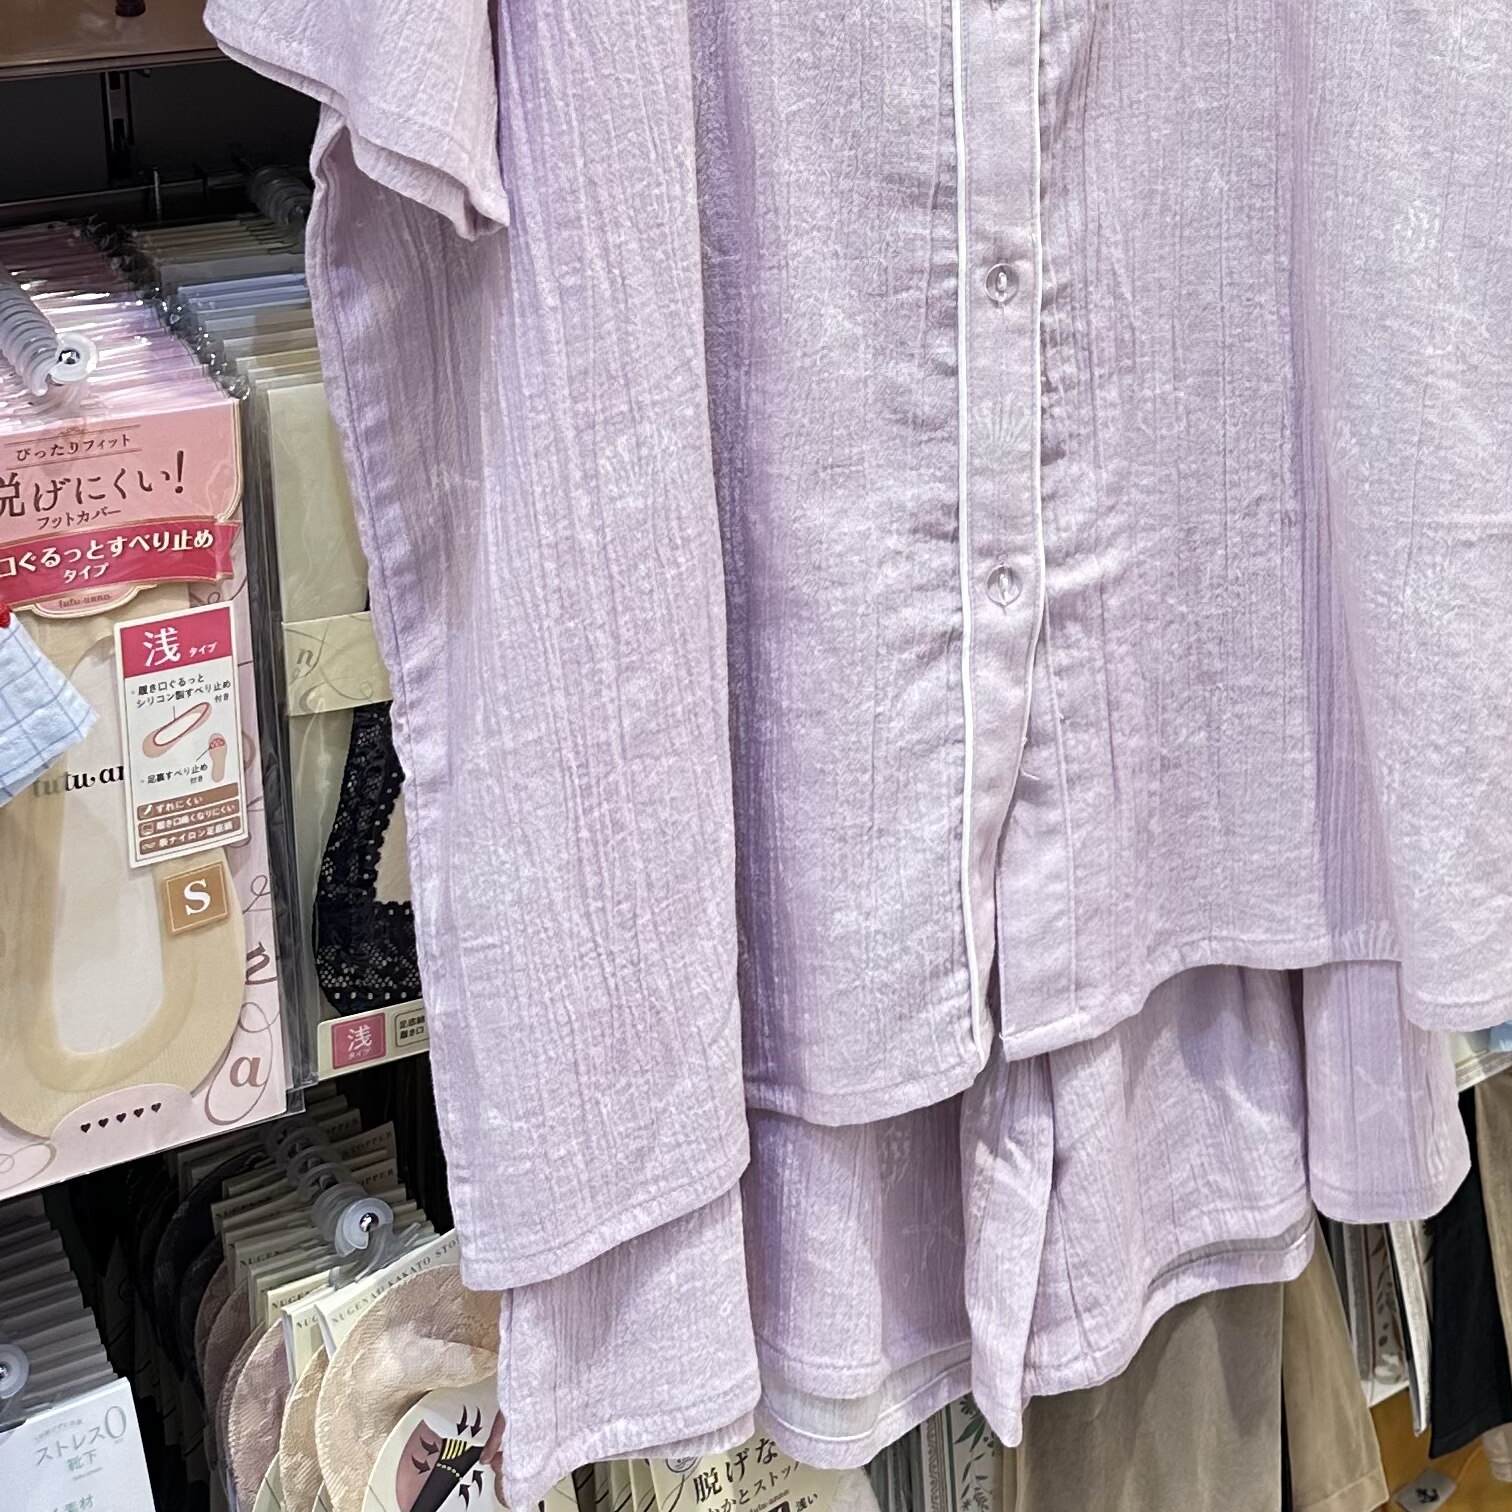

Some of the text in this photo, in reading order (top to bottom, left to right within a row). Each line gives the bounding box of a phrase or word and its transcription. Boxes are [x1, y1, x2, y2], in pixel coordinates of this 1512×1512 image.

[37, 505, 122, 531] フットカバー
[63, 561, 110, 583] タイプ
[143, 626, 218, 667] 浅 タイプ
[156, 796, 204, 814] ずれにくい
[183, 878, 211, 916] S
[347, 1024, 373, 1051] 浅
